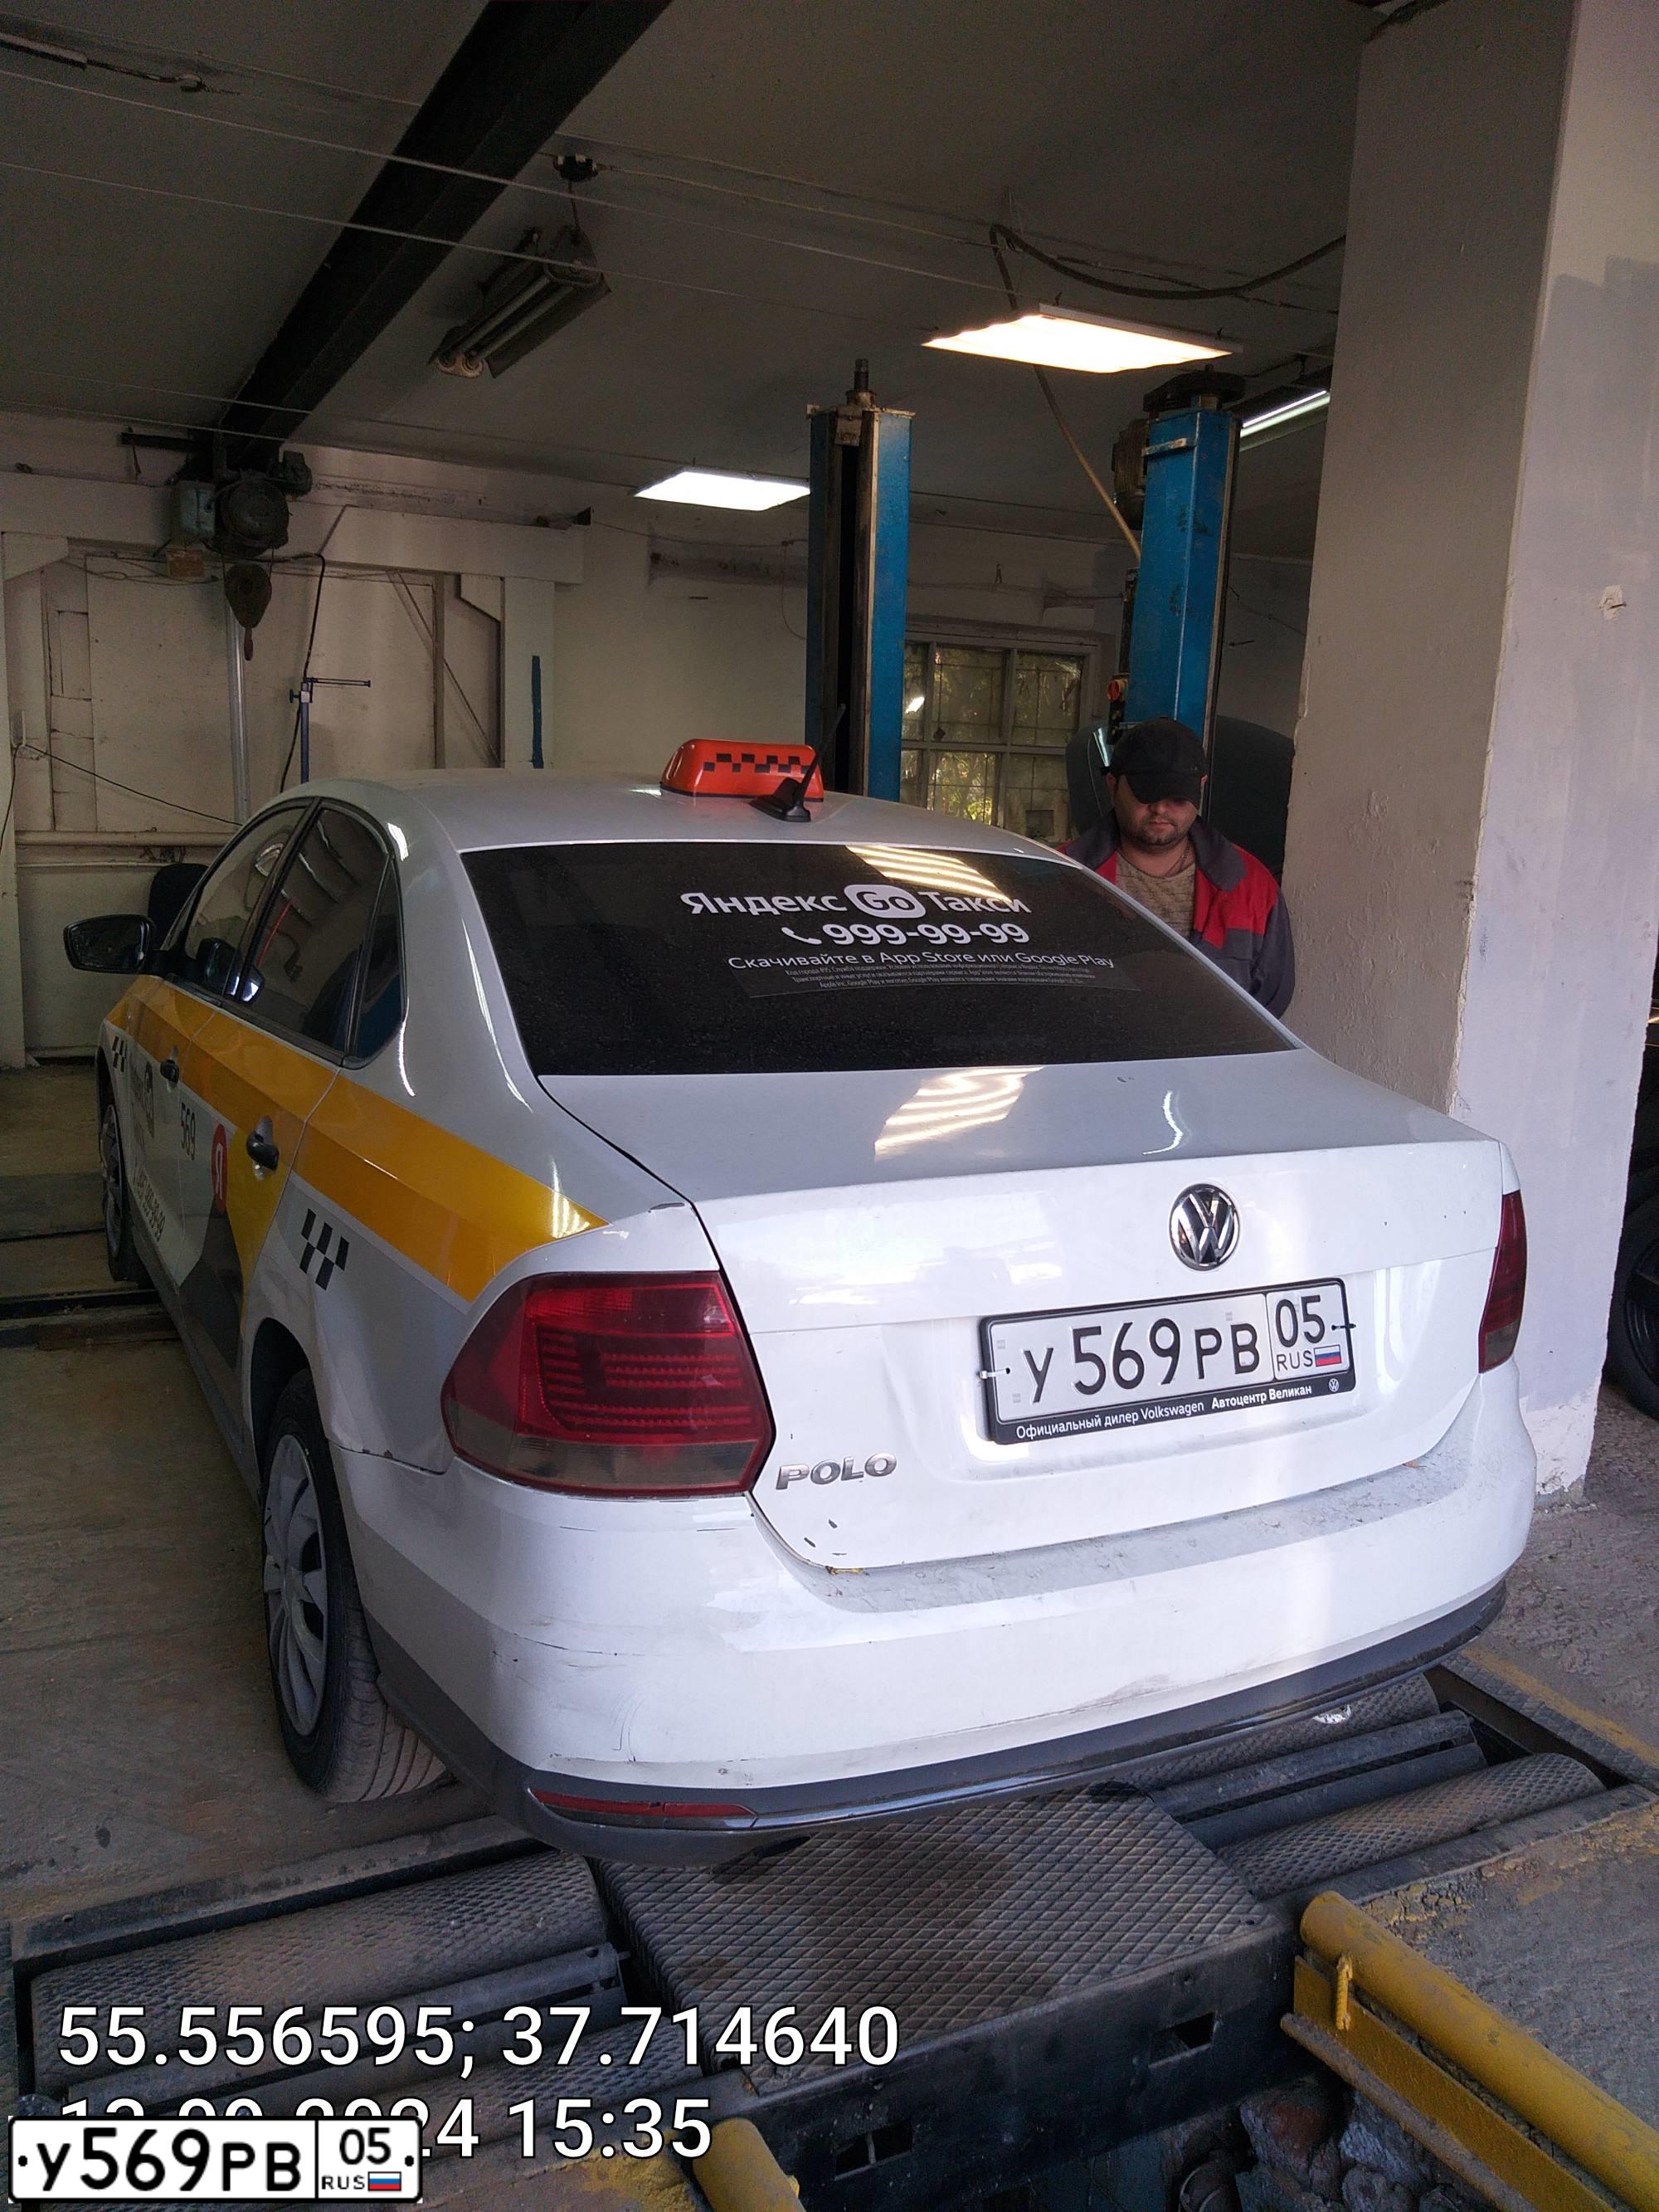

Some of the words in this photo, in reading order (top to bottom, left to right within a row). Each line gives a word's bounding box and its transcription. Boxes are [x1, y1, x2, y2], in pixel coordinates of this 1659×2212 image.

[680, 893, 847, 915] Яндекс
[856, 891, 916, 911] Go
[917, 892, 1032, 913] Такси
[822, 923, 1029, 945] 999-99-99
[728, 954, 859, 969] Скачивайте
[862, 955, 875, 963] в
[880, 953, 920, 964] App
[922, 952, 975, 962] Store
[977, 954, 1014, 962] или
[1014, 953, 1079, 966] Google
[1078, 955, 1115, 968] Play
[1274, 1294, 1326, 1347] 05
[1276, 1352, 1314, 1372] RUS
[1016, 1415, 1102, 1440] Официальный
[1104, 1411, 1139, 1427] дилер
[1141, 1402, 1204, 1420] Volkswagen
[1211, 1392, 1267, 1410] Автоцентр
[1269, 1385, 1312, 1401] Великан
[776, 1452, 897, 1490] POLO
